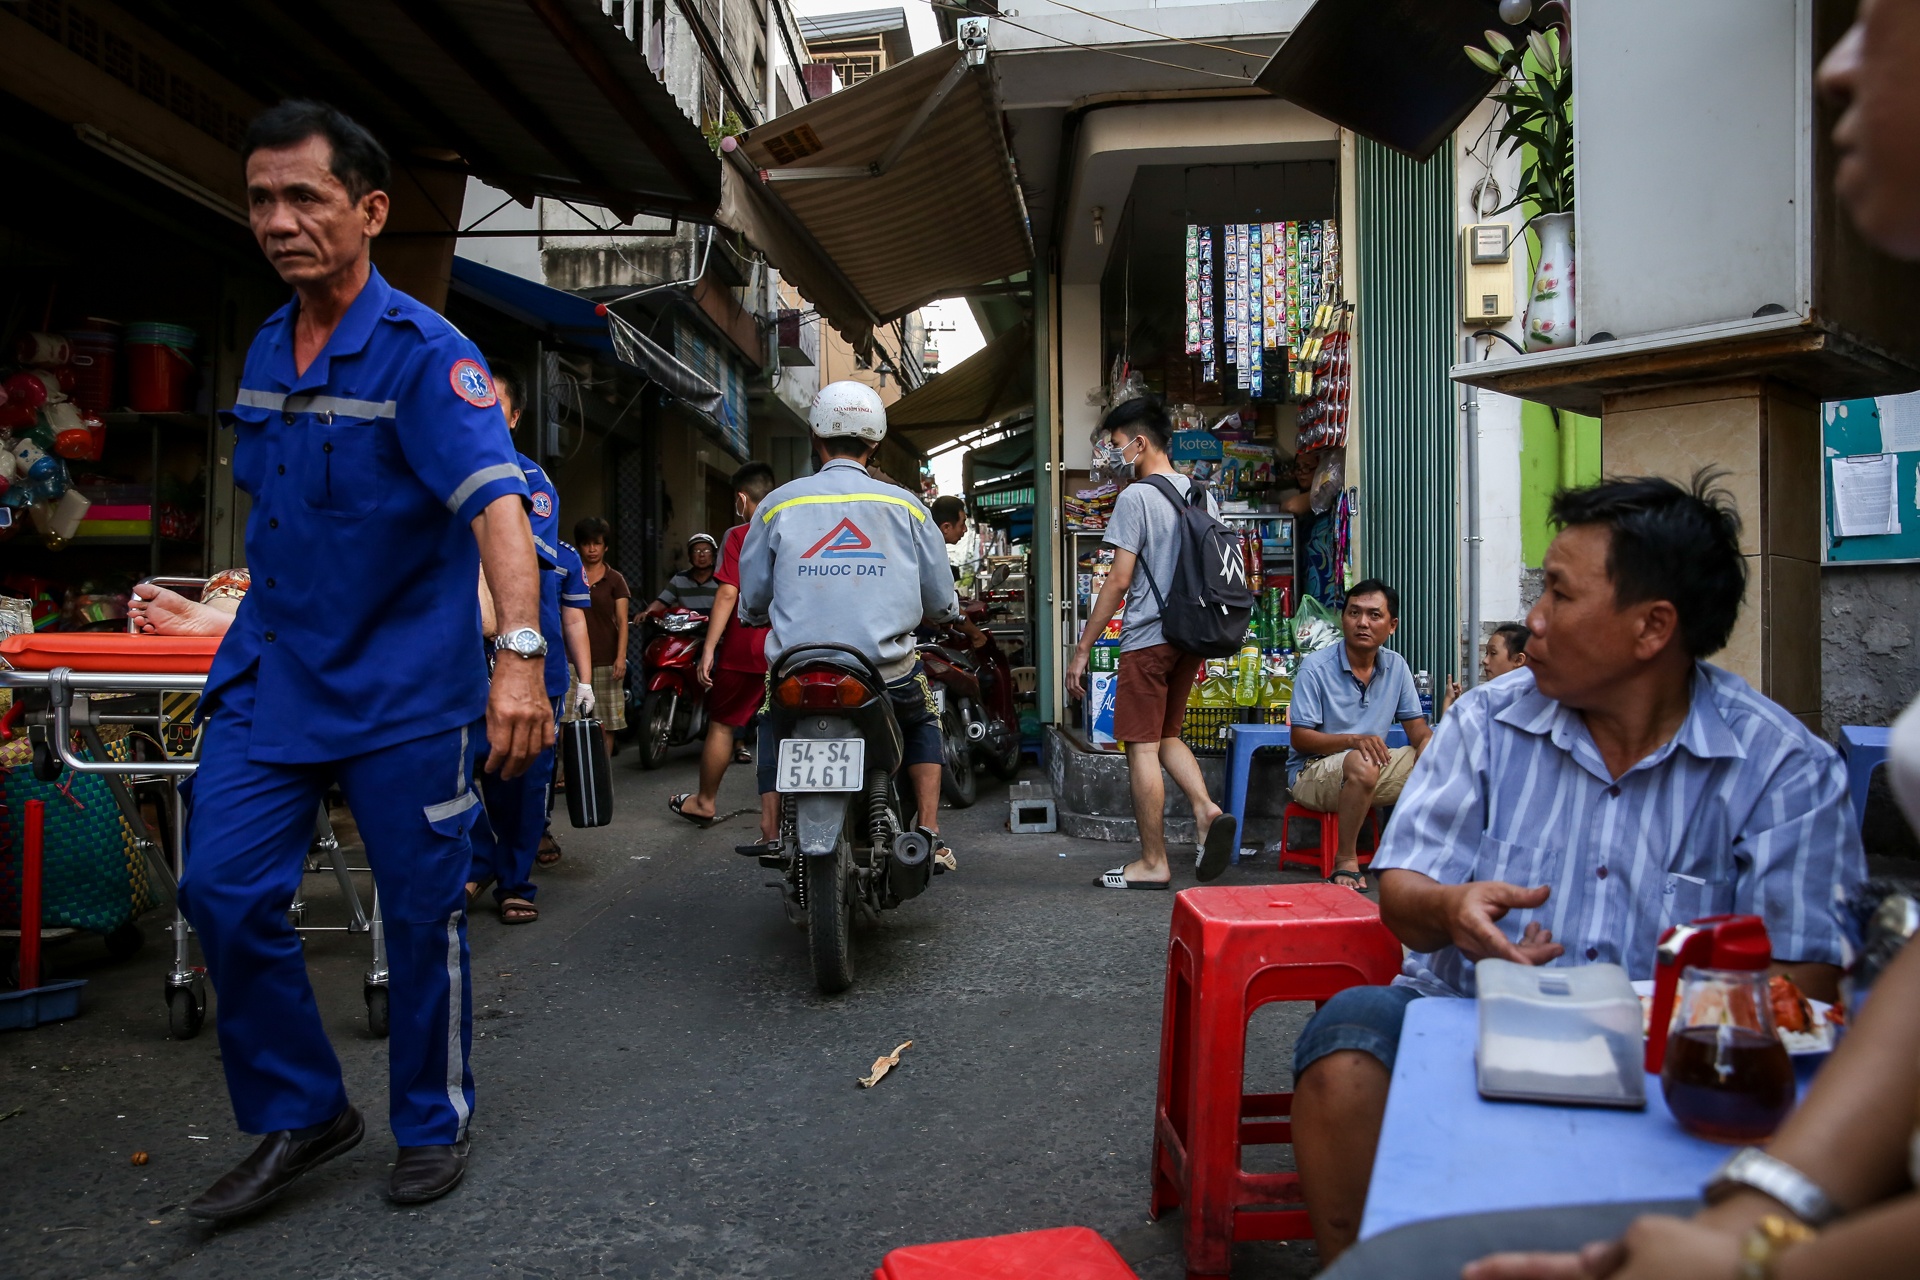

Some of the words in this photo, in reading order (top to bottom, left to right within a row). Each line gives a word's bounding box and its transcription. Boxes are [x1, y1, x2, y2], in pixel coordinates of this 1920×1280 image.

[1179, 436, 1217, 450] kotex
[798, 564, 851, 576] PHUOC
[856, 564, 886, 577] DAT
[791, 743, 850, 763] 54-S4
[790, 766, 847, 787] 5461
